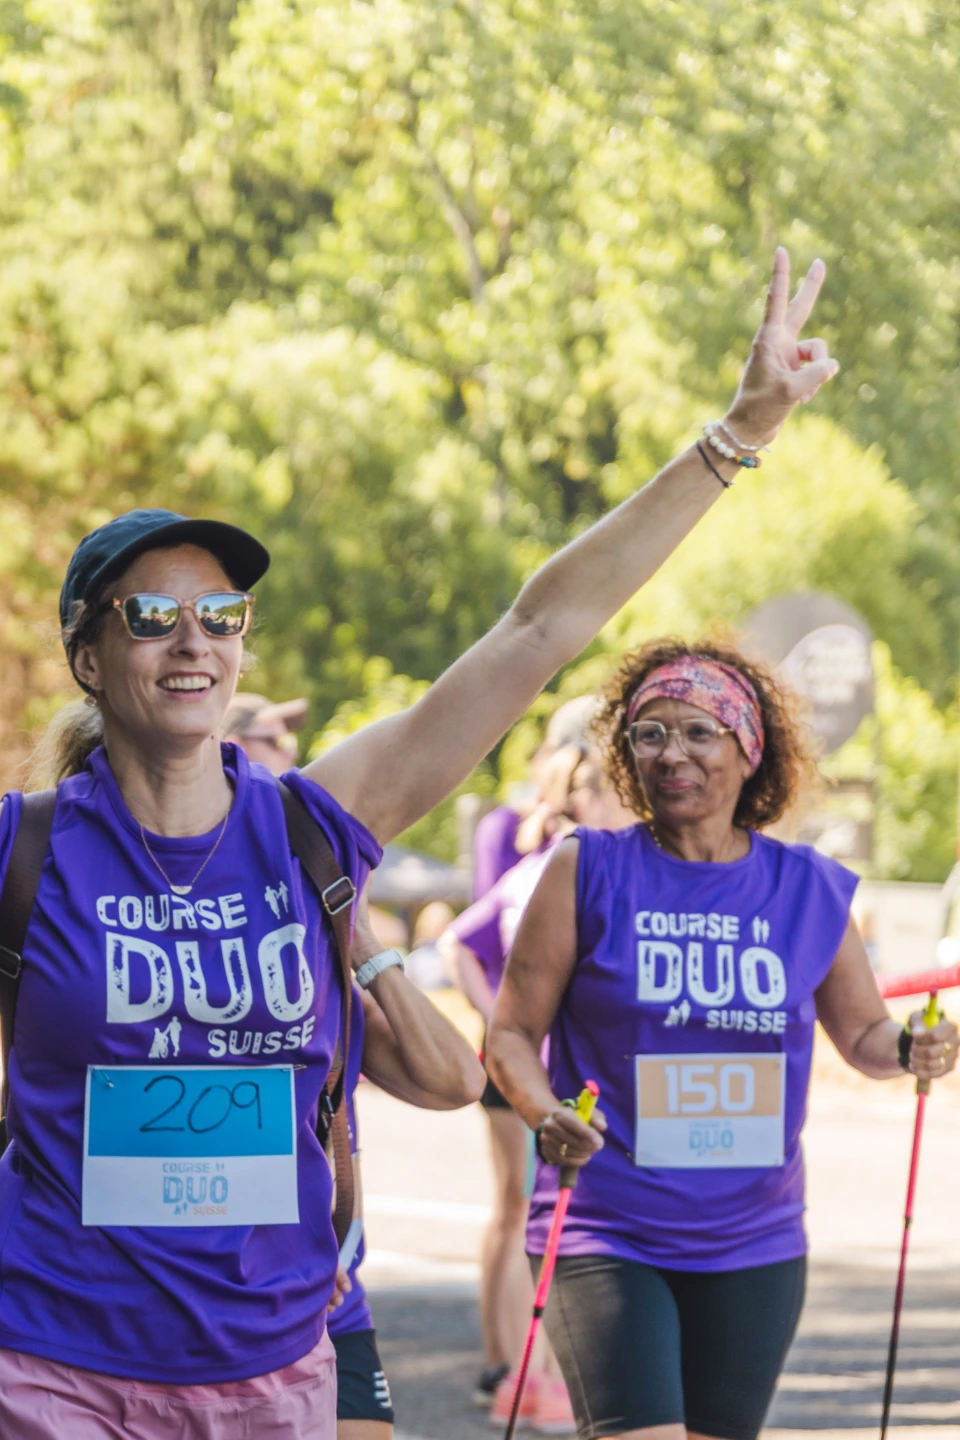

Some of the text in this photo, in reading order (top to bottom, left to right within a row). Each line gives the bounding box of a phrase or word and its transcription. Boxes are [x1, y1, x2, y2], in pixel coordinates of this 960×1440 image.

[96, 893, 248, 931] COURSE
[635, 911, 739, 940] COURSE
[106, 922, 315, 1024] DUO
[637, 940, 787, 1008] DUO
[208, 1015, 316, 1058] SUISSE
[706, 1009, 787, 1034] SUISSE
[139, 1074, 263, 1134] 209
[664, 1064, 755, 1114] 150
[689, 1129, 734, 1149] DUO
[162, 1162, 210, 1173] COURSE
[163, 1175, 228, 1204] DUO
